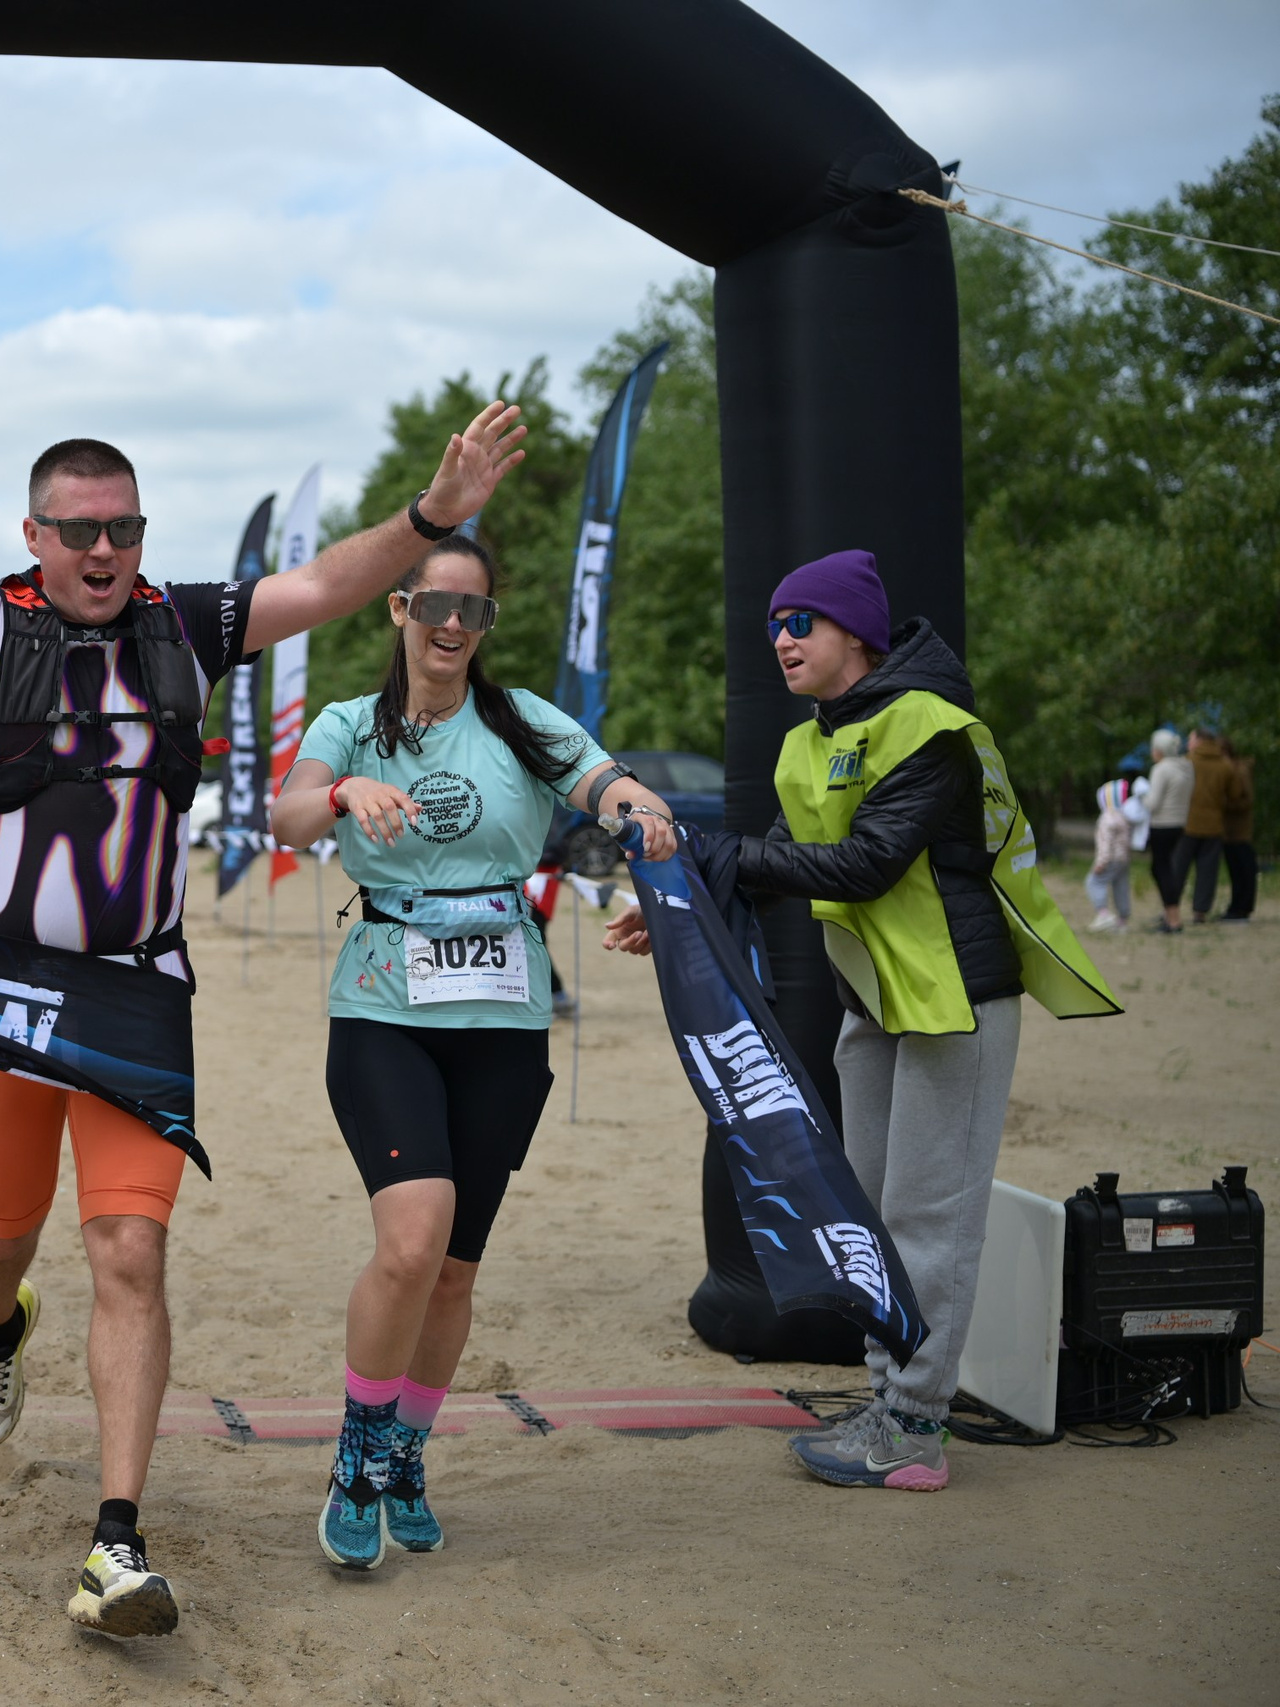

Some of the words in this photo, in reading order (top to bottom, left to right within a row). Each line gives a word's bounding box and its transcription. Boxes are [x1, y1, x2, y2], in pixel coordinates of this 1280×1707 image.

[418, 803, 469, 816] ородской
[433, 822, 459, 835] 2025
[429, 935, 507, 970] 1025
[713, 1088, 739, 1125] TRAIL
